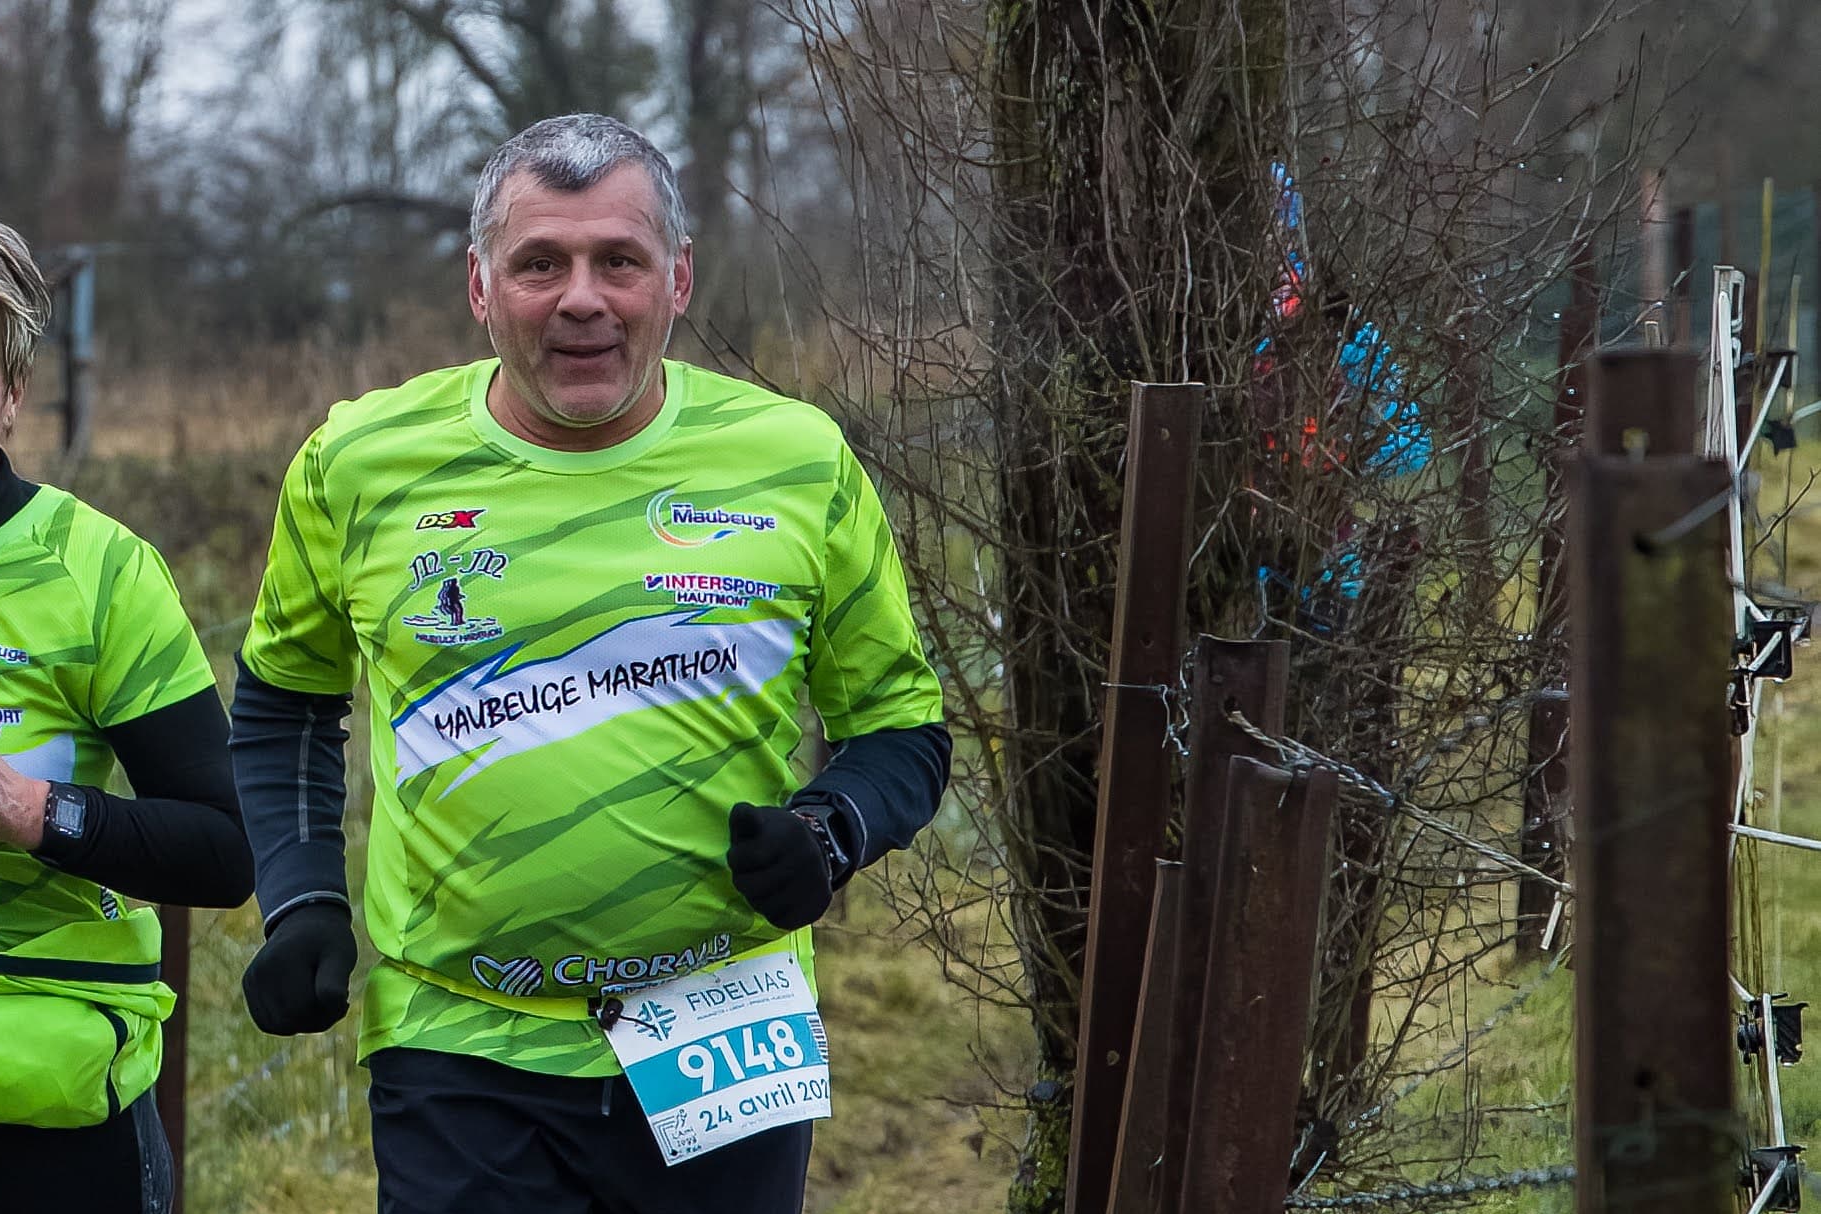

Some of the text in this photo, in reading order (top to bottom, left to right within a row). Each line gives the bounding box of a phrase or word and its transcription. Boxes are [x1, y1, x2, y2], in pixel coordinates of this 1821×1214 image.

[671, 508, 777, 531] Maubeuge
[665, 574, 779, 599] INTERSPORT
[677, 591, 749, 607] HAUTMONT
[433, 643, 739, 741] MAUBEUGE MARATHON
[685, 969, 791, 1012] FIDELIAS
[677, 1021, 805, 1093] 9148
[699, 1105, 733, 1132] 24
[739, 1082, 795, 1117] avril
